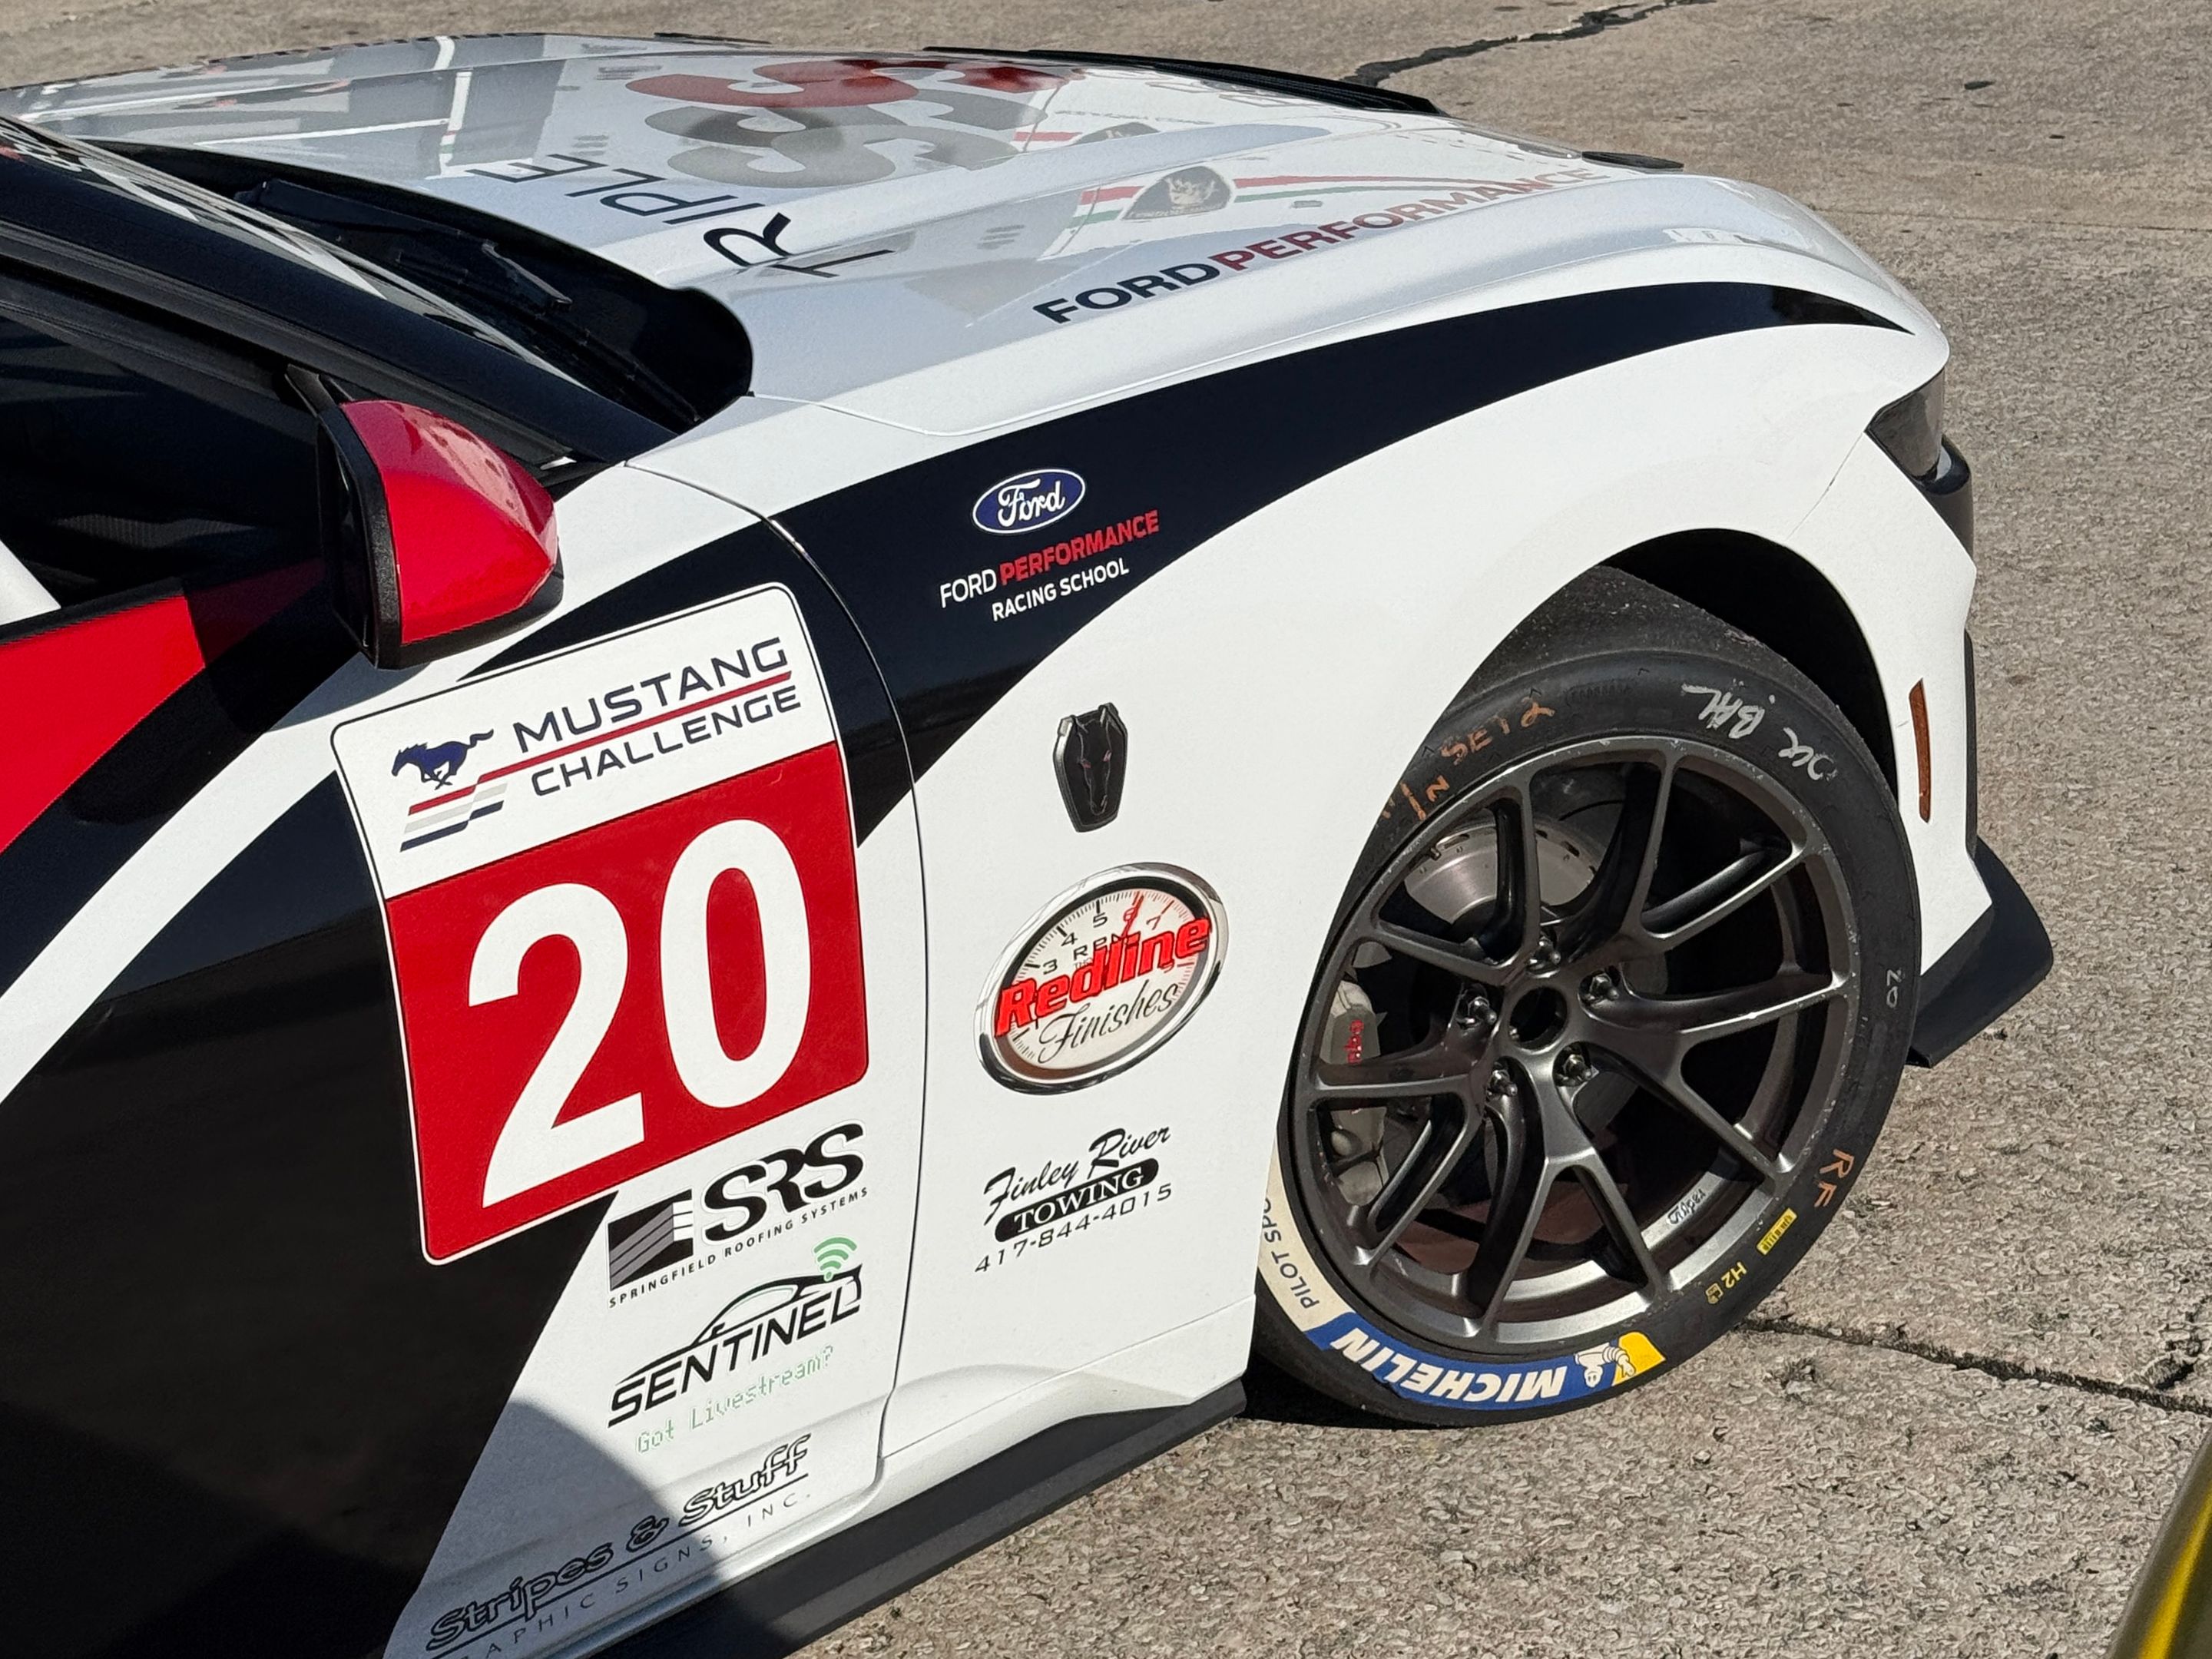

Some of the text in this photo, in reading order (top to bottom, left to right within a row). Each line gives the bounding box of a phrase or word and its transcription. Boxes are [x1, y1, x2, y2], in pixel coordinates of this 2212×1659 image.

[465, 154, 894, 279] TRIPLE
[1034, 168, 1611, 324] FORD PERFORMANCE
[998, 478, 1066, 527] Ford
[940, 509, 1161, 608] FORD PERFORMANCE
[992, 558, 1130, 622] RACING SCHOOL
[513, 637, 789, 753] MUSTANG
[531, 685, 802, 796] CHALLENGE
[1042, 959, 1058, 975] 3
[1061, 932, 1078, 947] 4
[1092, 912, 1108, 929] 5
[1146, 915, 1161, 931] 7
[469, 819, 811, 1209] 20
[994, 916, 1213, 1038] Redline
[1038, 979, 1179, 1064] Finishes
[704, 1123, 864, 1242] SRS
[983, 1126, 1171, 1226] Finley River
[1014, 1166, 1144, 1233] TOWING
[1813, 1148, 1855, 1208] RF
[609, 1187, 868, 1308] SPRINGFIELD ROOFING SYSTEMS
[975, 1183, 1172, 1272] 417-844-4015
[1721, 1262, 1747, 1289] H2
[1271, 1250, 1320, 1309] PILOT
[608, 1286, 861, 1429] SENTINEL
[637, 1344, 834, 1454] Got Livestream?
[1330, 1327, 1568, 1402] MICHELIN
[426, 1433, 812, 1651] Stripes & Stuff
[459, 1492, 813, 1659] APHIC SIGNS, INC.
